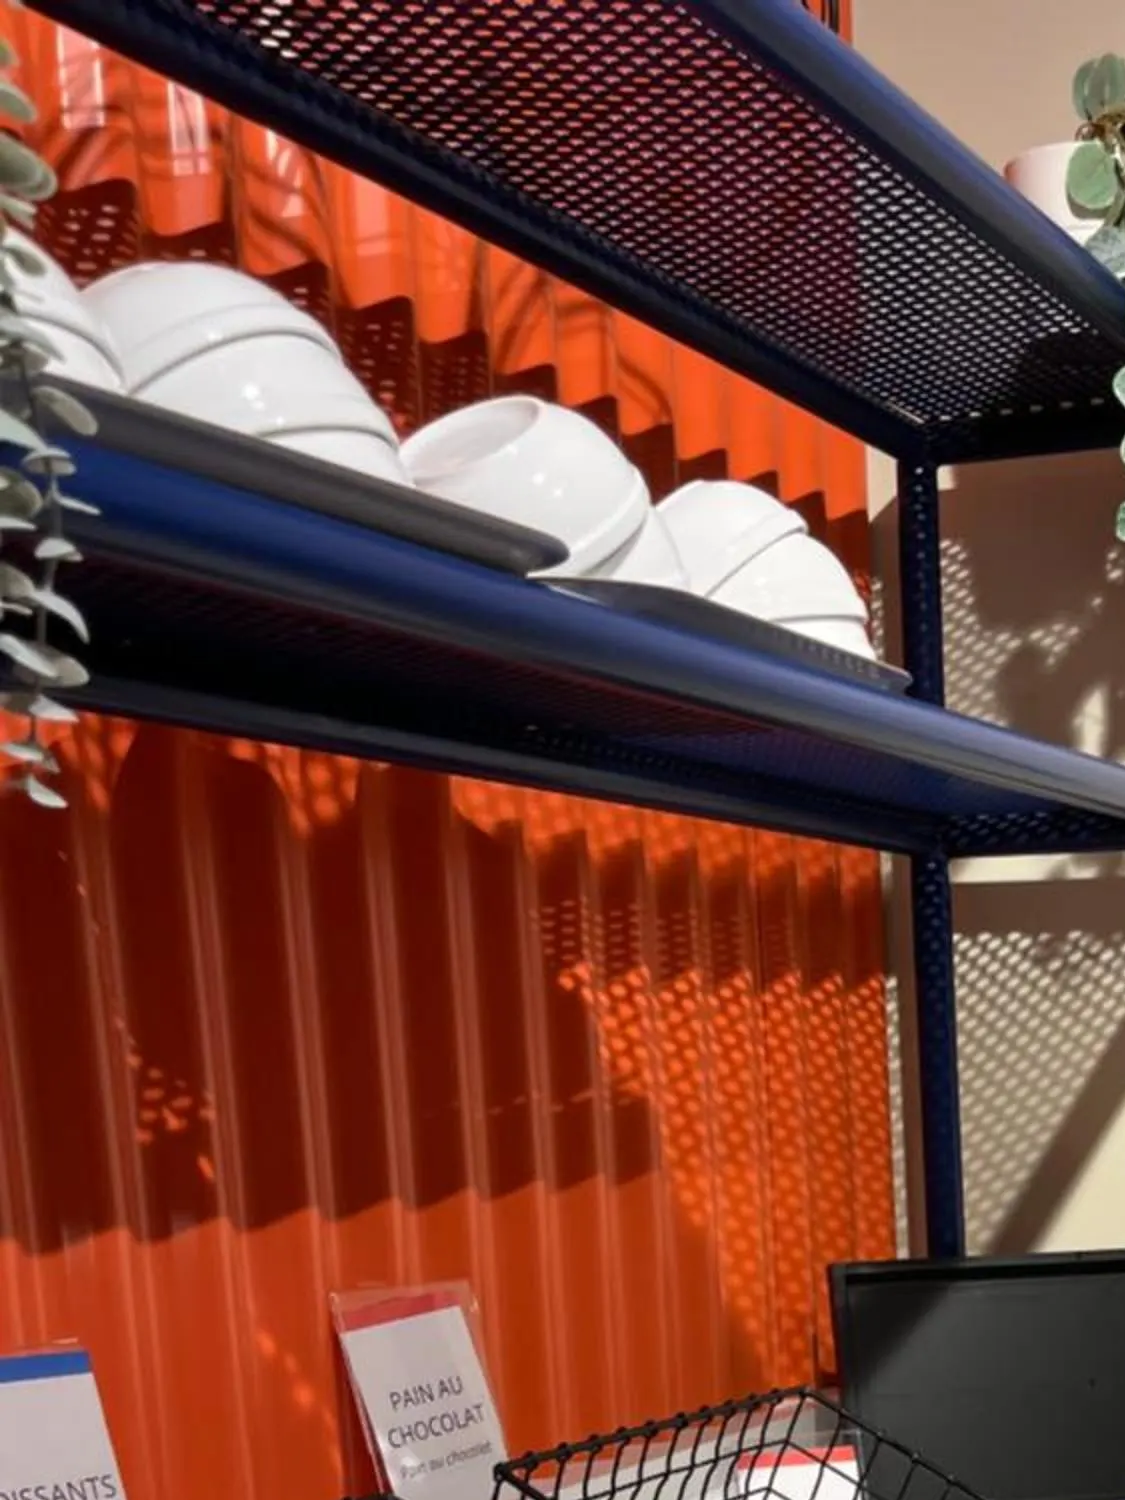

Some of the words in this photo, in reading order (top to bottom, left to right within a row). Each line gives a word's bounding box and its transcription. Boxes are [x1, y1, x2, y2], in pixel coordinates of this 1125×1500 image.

[389, 1383, 434, 1412] PAIN
[438, 1375, 464, 1399] AU
[388, 1402, 485, 1449] CHOCOLAT
